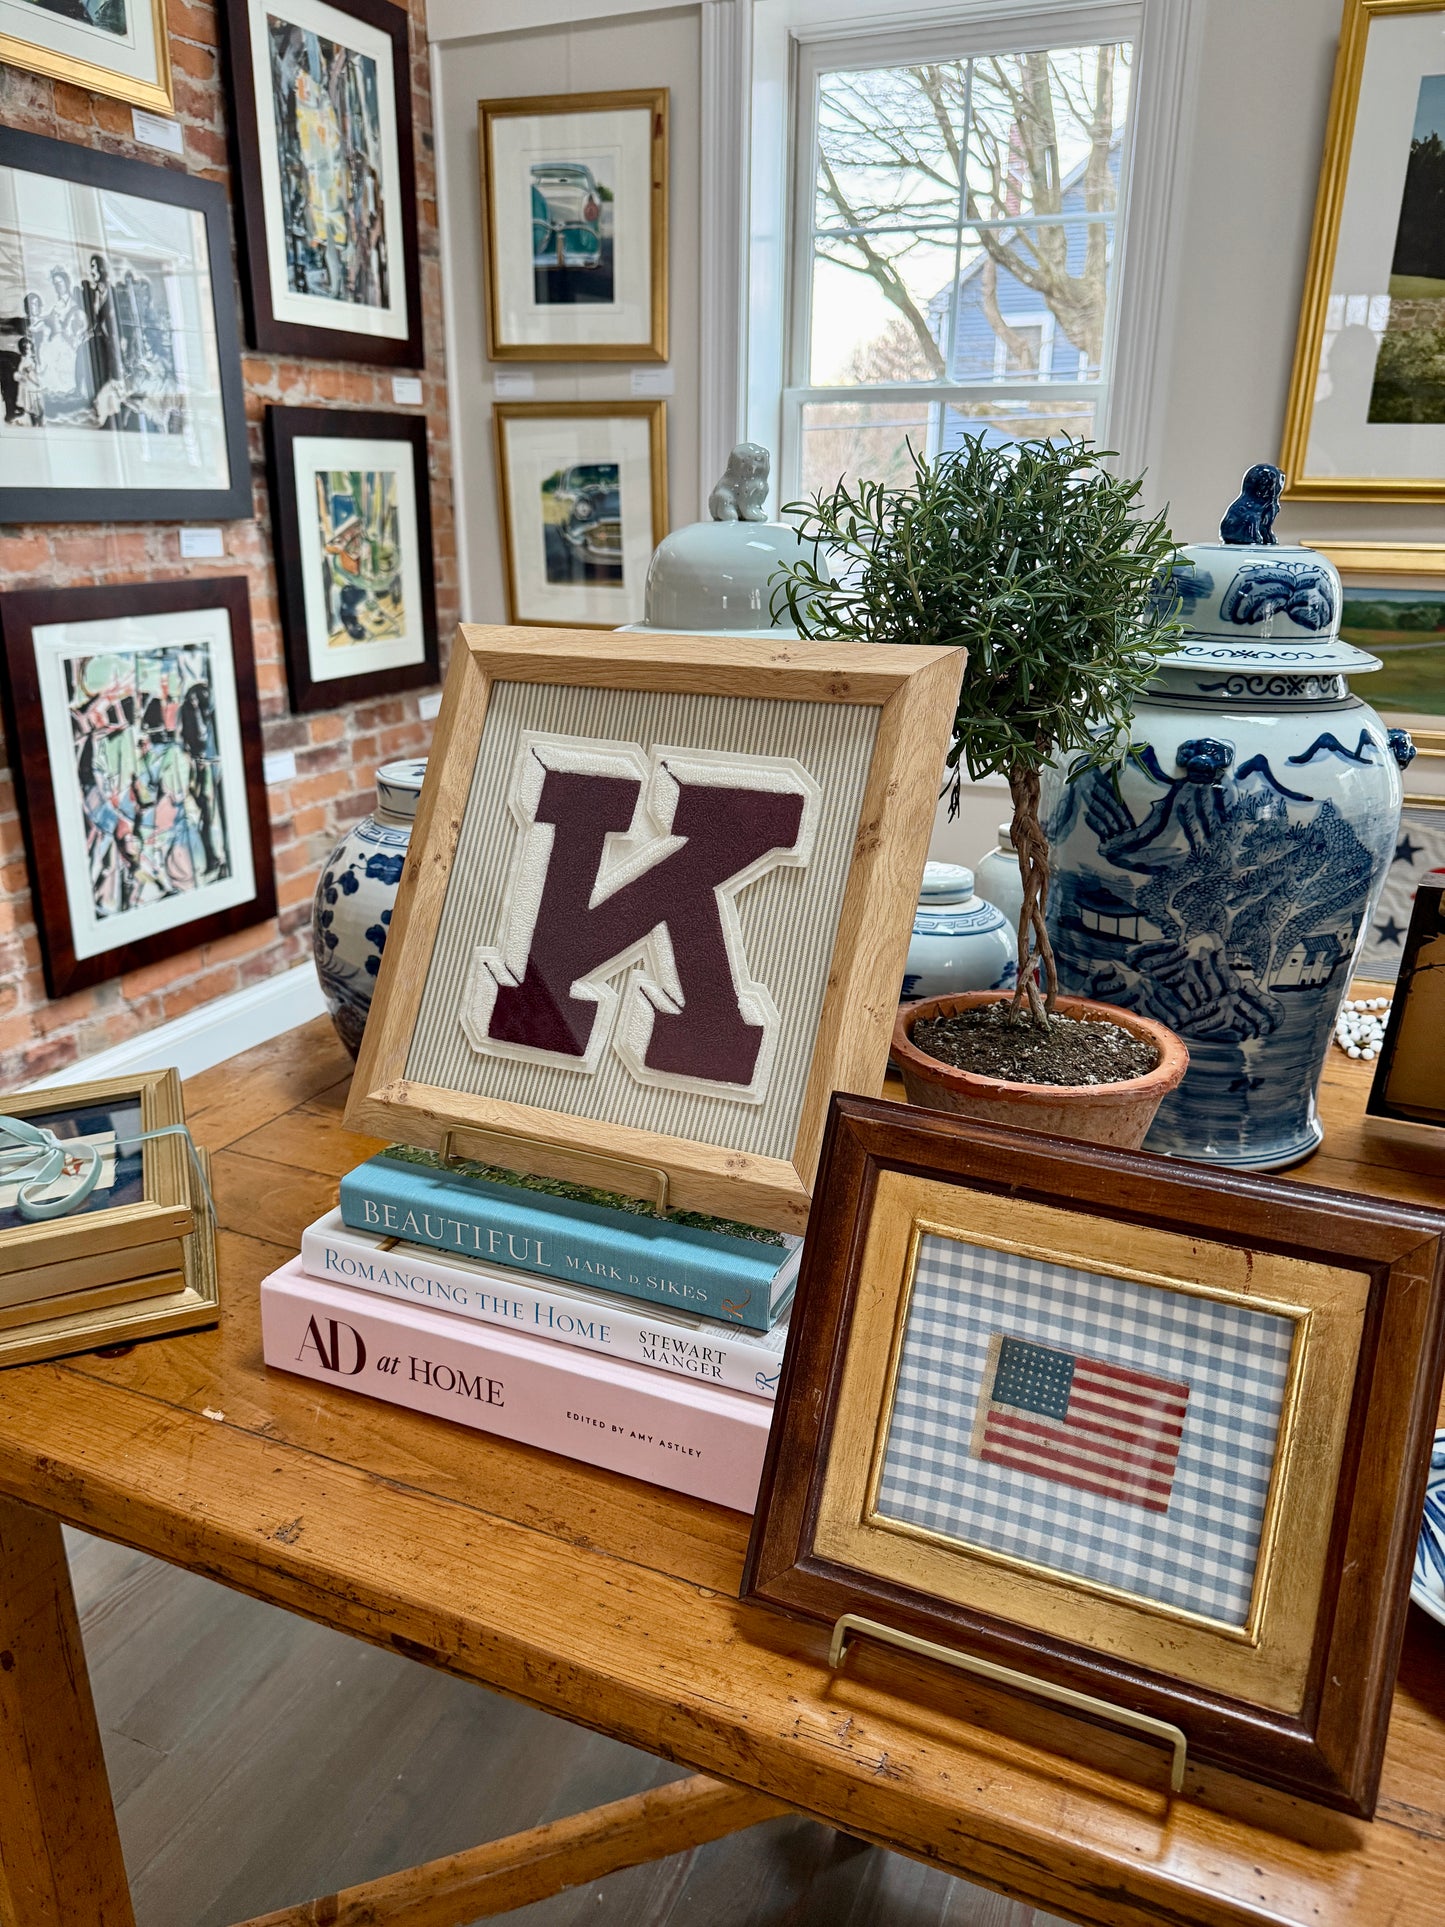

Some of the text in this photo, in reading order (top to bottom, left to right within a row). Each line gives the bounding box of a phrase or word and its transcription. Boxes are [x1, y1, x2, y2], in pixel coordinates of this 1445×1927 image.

[461, 732, 820, 1104] K
[363, 1199, 552, 1267] BEAUTIFUL
[324, 1248, 611, 1343] ROMANCING THE HOME
[566, 1255, 622, 1280] MARK
[646, 1276, 708, 1302] SIKES
[295, 1313, 505, 1408] AD at HOME
[638, 1330, 727, 1365] STEWART
[642, 1346, 724, 1380] MANGER
[566, 1411, 702, 1458] EDITED BY AMY ASTLEY
